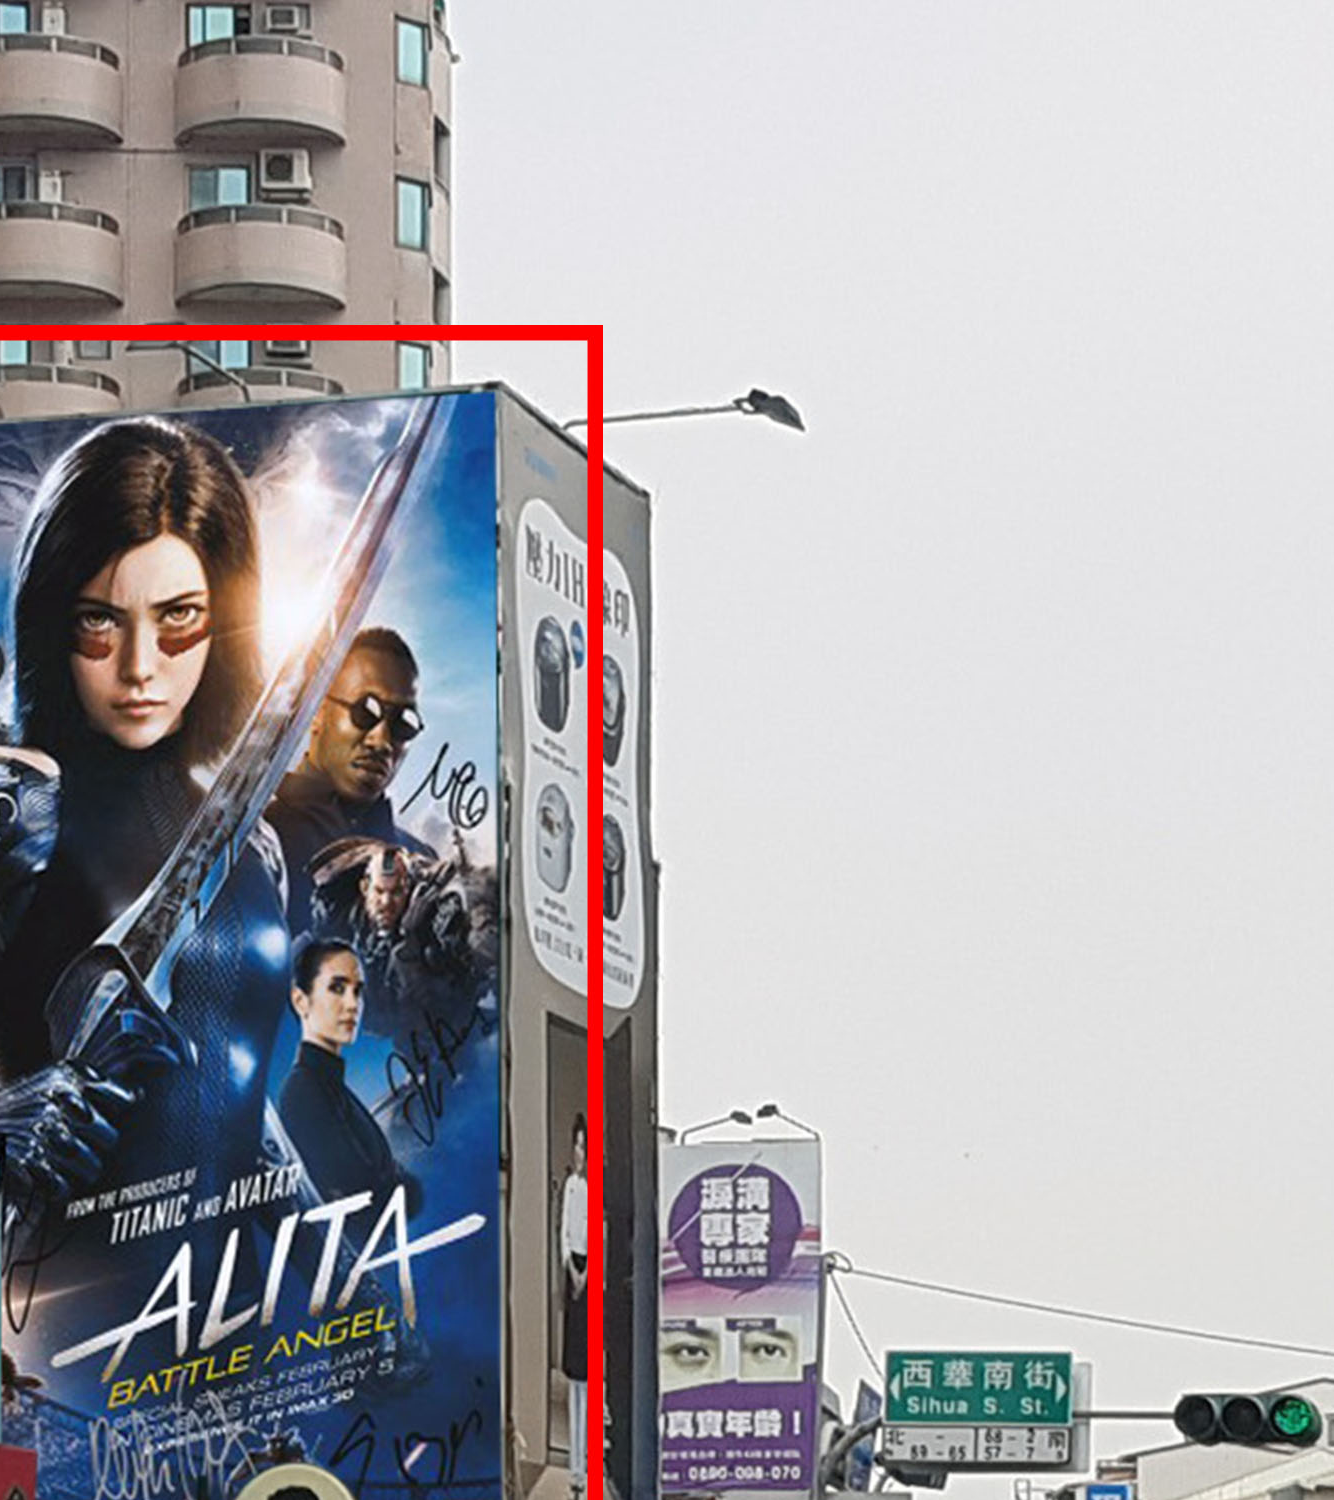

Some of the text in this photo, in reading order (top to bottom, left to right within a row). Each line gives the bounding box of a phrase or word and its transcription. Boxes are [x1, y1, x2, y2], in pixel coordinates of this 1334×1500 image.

[109, 1193, 190, 1245] TITANIC
[223, 1164, 303, 1214] AVATAR
[51, 1185, 487, 1383] ALITA
[107, 1305, 397, 1409] BATTLE ANGEL
[276, 1344, 379, 1384] FEBRUARY
[902, 1359, 1056, 1391] 西華南街
[249, 1365, 372, 1411] FEBRUARY
[907, 1396, 1049, 1415] Sihua S. St.
